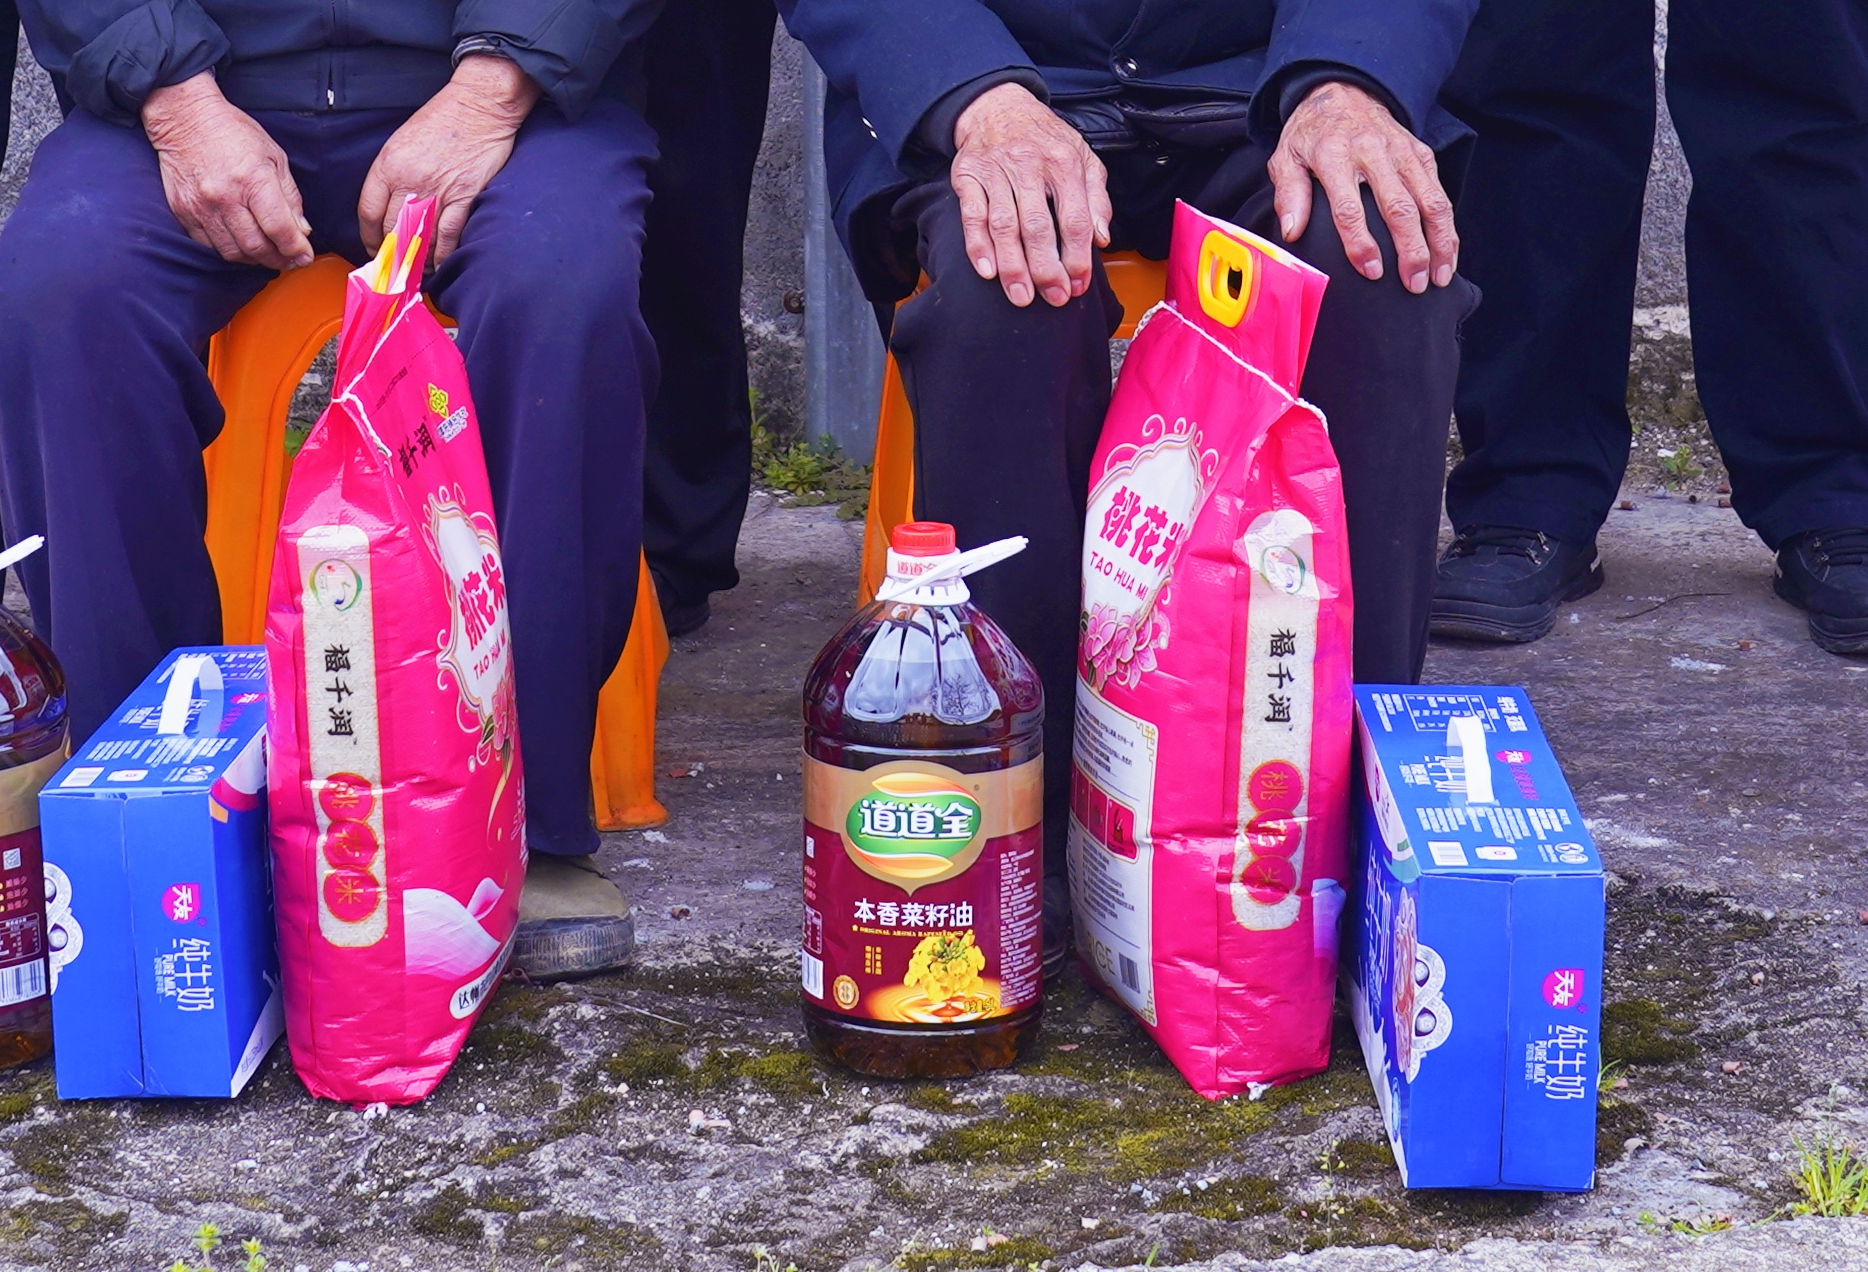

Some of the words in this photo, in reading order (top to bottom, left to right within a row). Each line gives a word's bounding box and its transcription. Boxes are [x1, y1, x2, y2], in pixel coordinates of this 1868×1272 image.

[1090, 551, 1113, 576] TAO
[1114, 568, 1135, 593] HUA
[323, 643, 355, 738] 福千润
[1263, 626, 1297, 724] 福千润
[859, 799, 973, 838] 道道全
[854, 897, 973, 927] 本香菜籽油
[173, 937, 215, 1012] 纯牛奶
[1534, 1040, 1547, 1062] PURE
[1545, 1024, 1589, 1100] 纯牛奶
[1533, 1063, 1546, 1084] MILK
